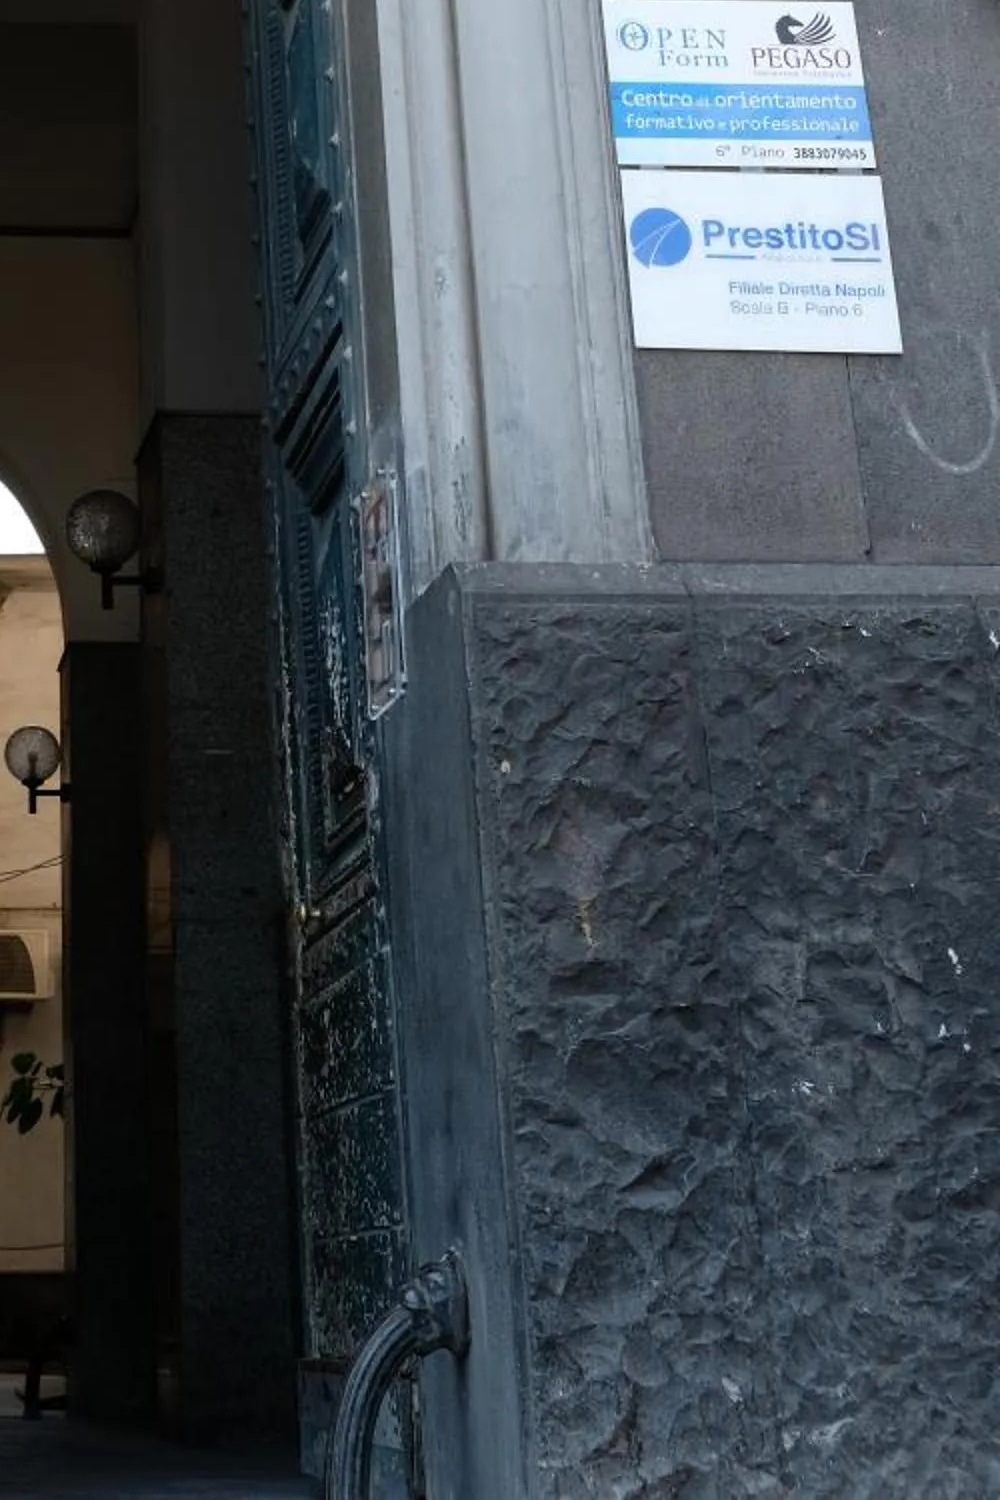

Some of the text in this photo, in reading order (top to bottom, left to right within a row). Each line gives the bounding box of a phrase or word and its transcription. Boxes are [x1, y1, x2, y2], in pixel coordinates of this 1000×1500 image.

[618, 20, 728, 51] OPEN
[658, 50, 729, 68] Form
[751, 47, 851, 69] PEGASO
[621, 90, 694, 107] Centro
[714, 90, 857, 110] orientamento
[626, 114, 715, 130] formativo
[729, 116, 860, 134] professionale
[741, 145, 785, 158] Piano
[702, 219, 881, 251] PrestitoSI
[728, 281, 885, 300] Filiale Diretta Napoli
[730, 300, 773, 315] Scala
[805, 302, 849, 317] Piano
